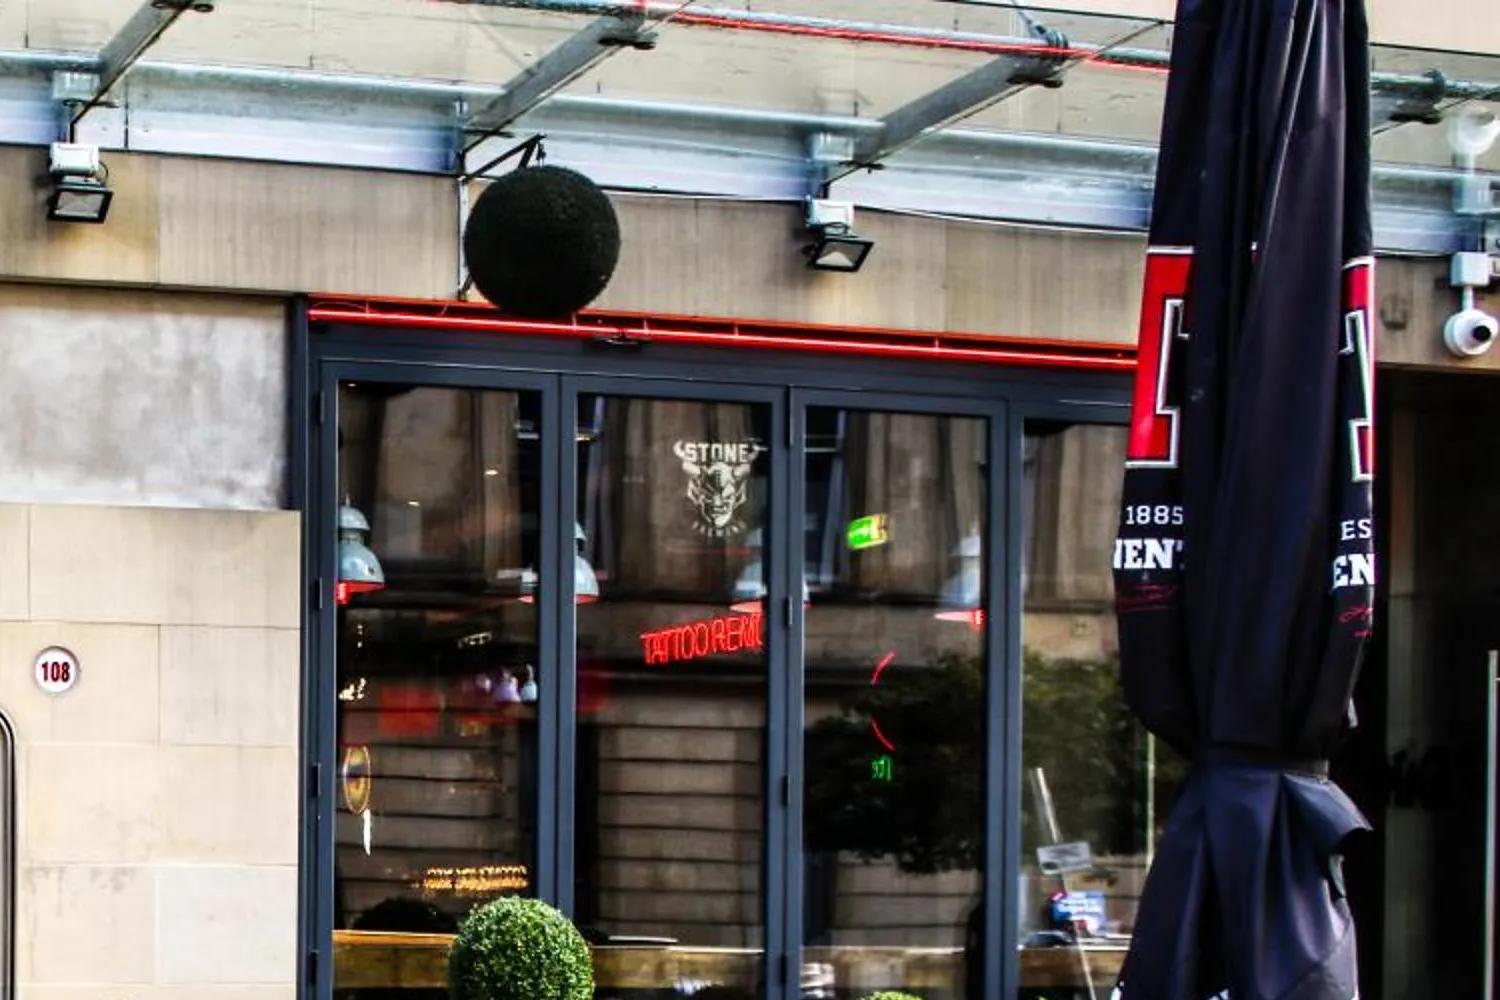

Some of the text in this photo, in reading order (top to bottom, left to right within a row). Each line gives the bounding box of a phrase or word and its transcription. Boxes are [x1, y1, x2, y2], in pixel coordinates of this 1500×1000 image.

[684, 442, 749, 463] STONE
[1125, 505, 1184, 525] 1885
[640, 622, 709, 665] TATTOO
[41, 660, 70, 683] 108
